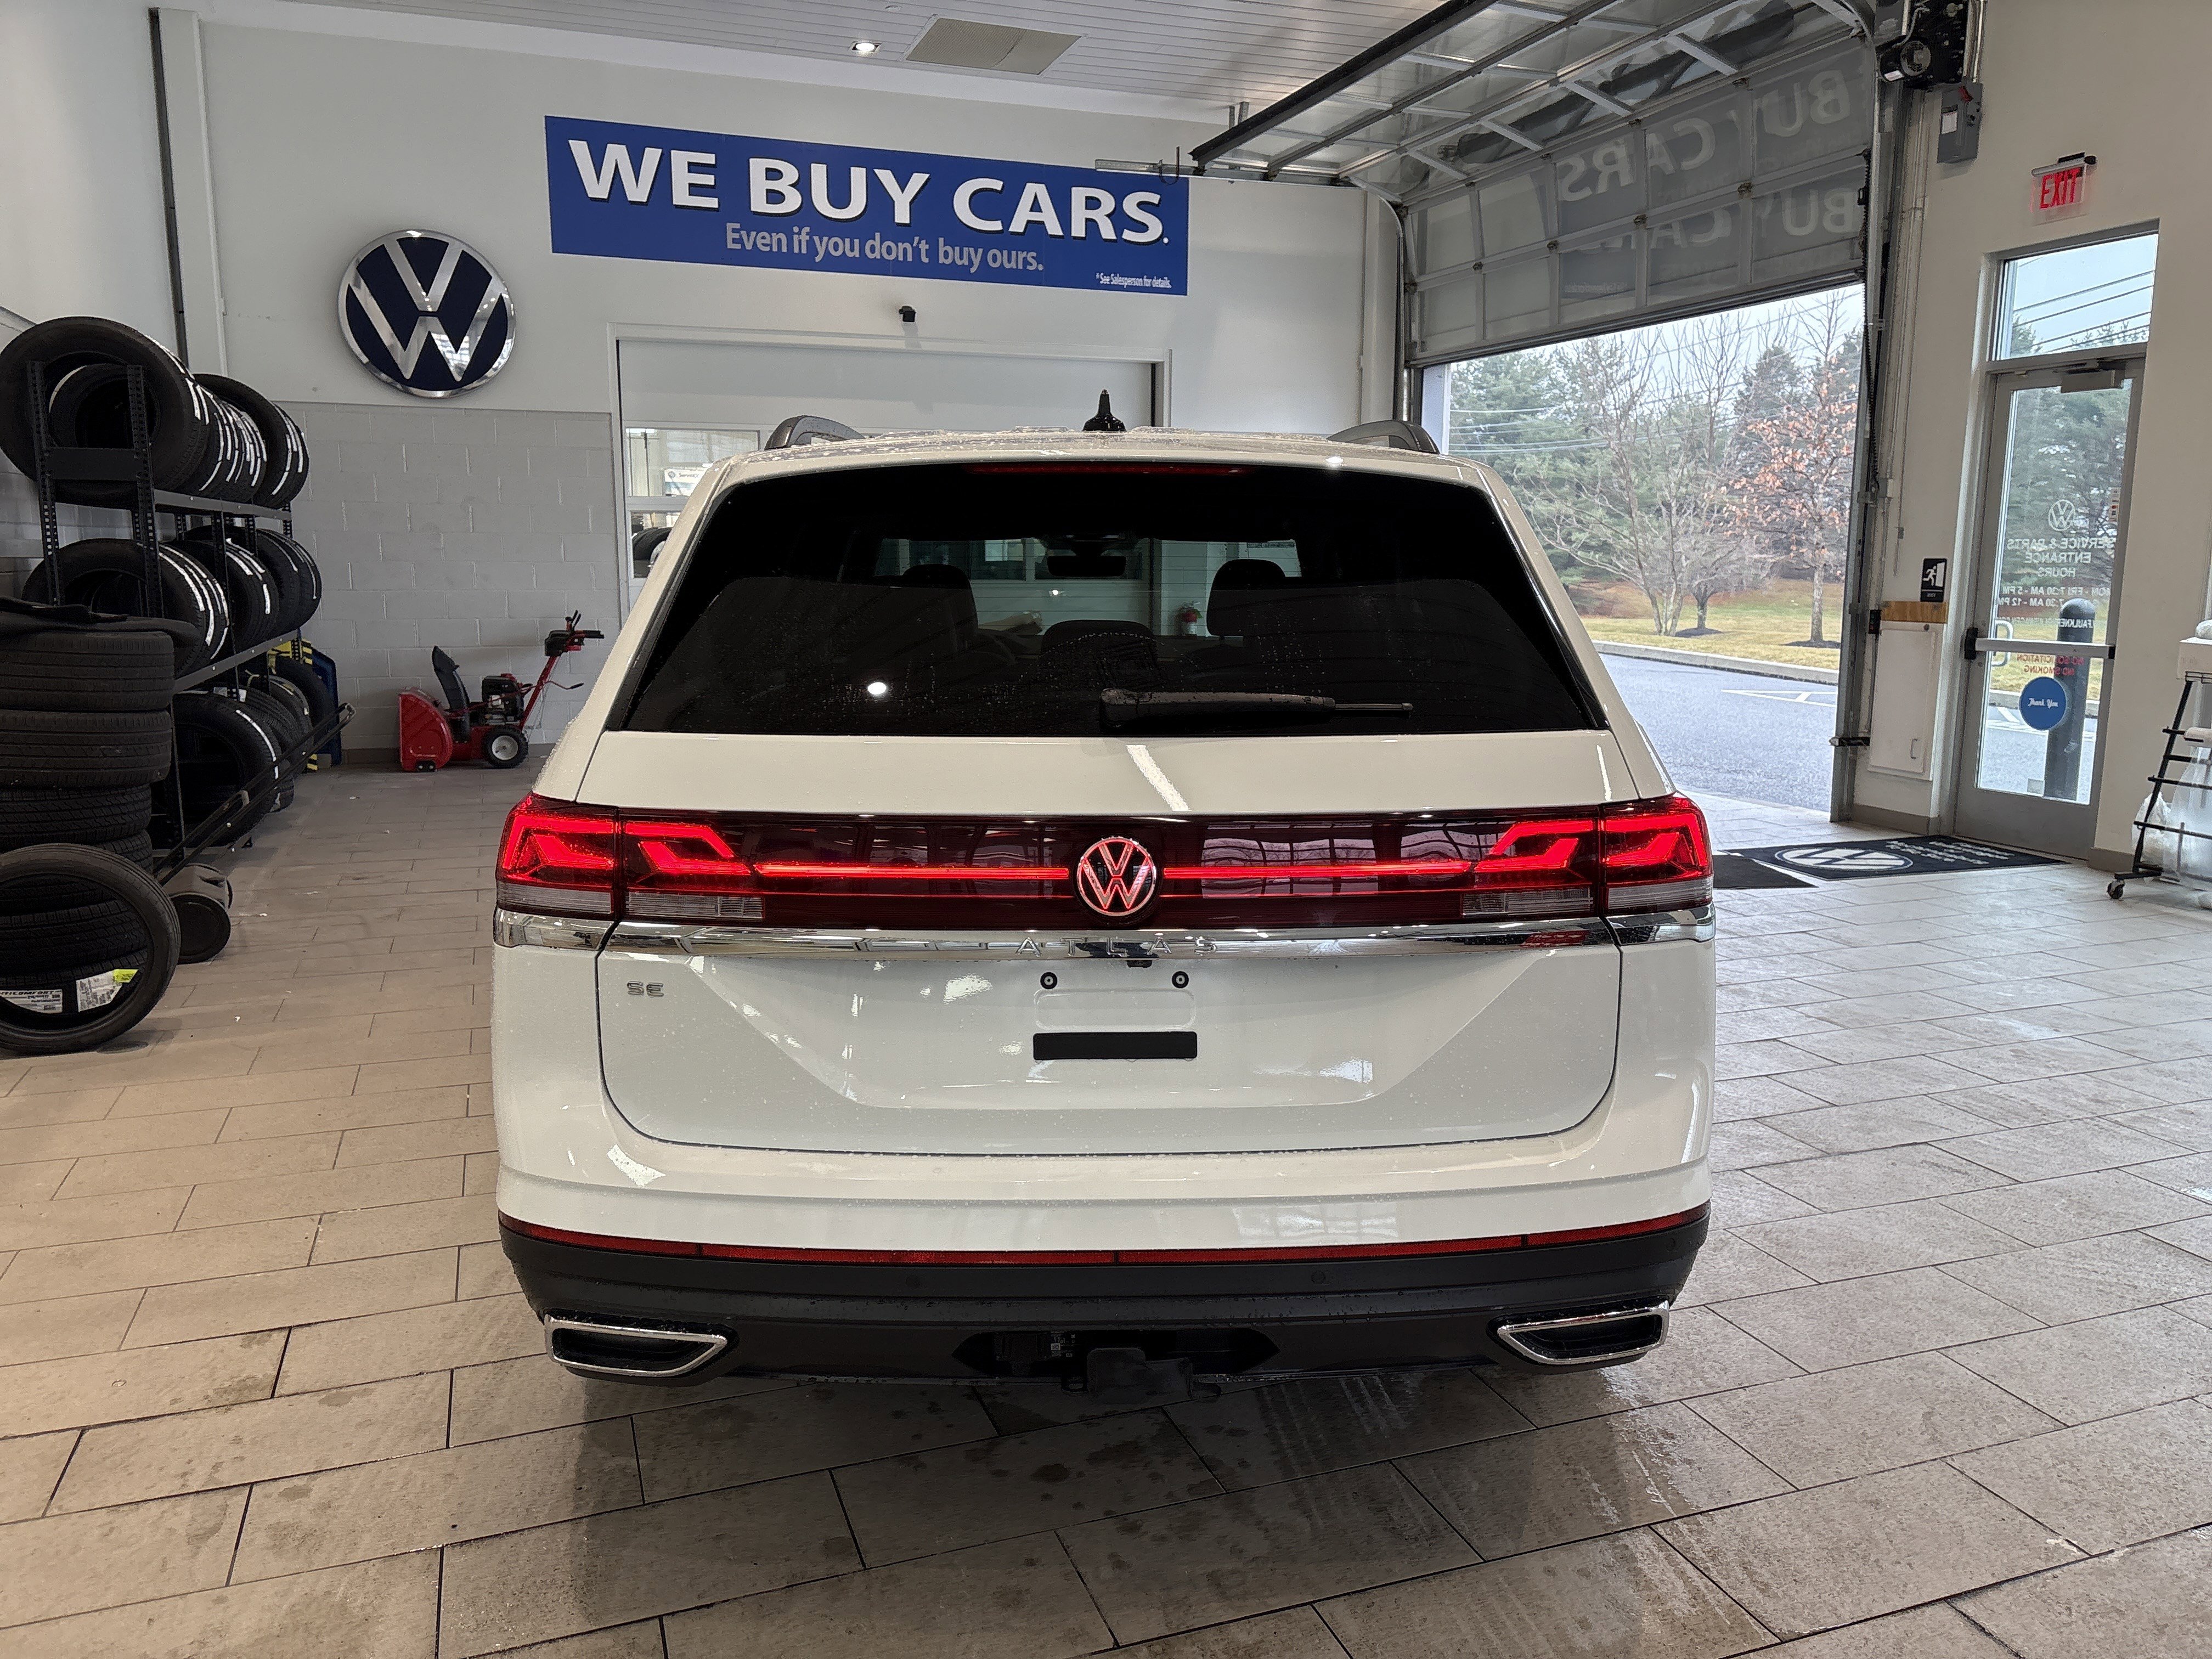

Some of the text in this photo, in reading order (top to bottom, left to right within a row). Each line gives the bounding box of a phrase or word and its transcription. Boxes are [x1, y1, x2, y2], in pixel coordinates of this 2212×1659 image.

[568, 139, 1169, 245] WE BUY CARS.
[2040, 167, 2081, 209] EXIT
[726, 222, 1044, 273] Even if you don't buy ours.
[1111, 273, 1142, 288] Salesperson
[1015, 936, 1217, 957] ATLAS
[627, 981, 664, 997] SE
